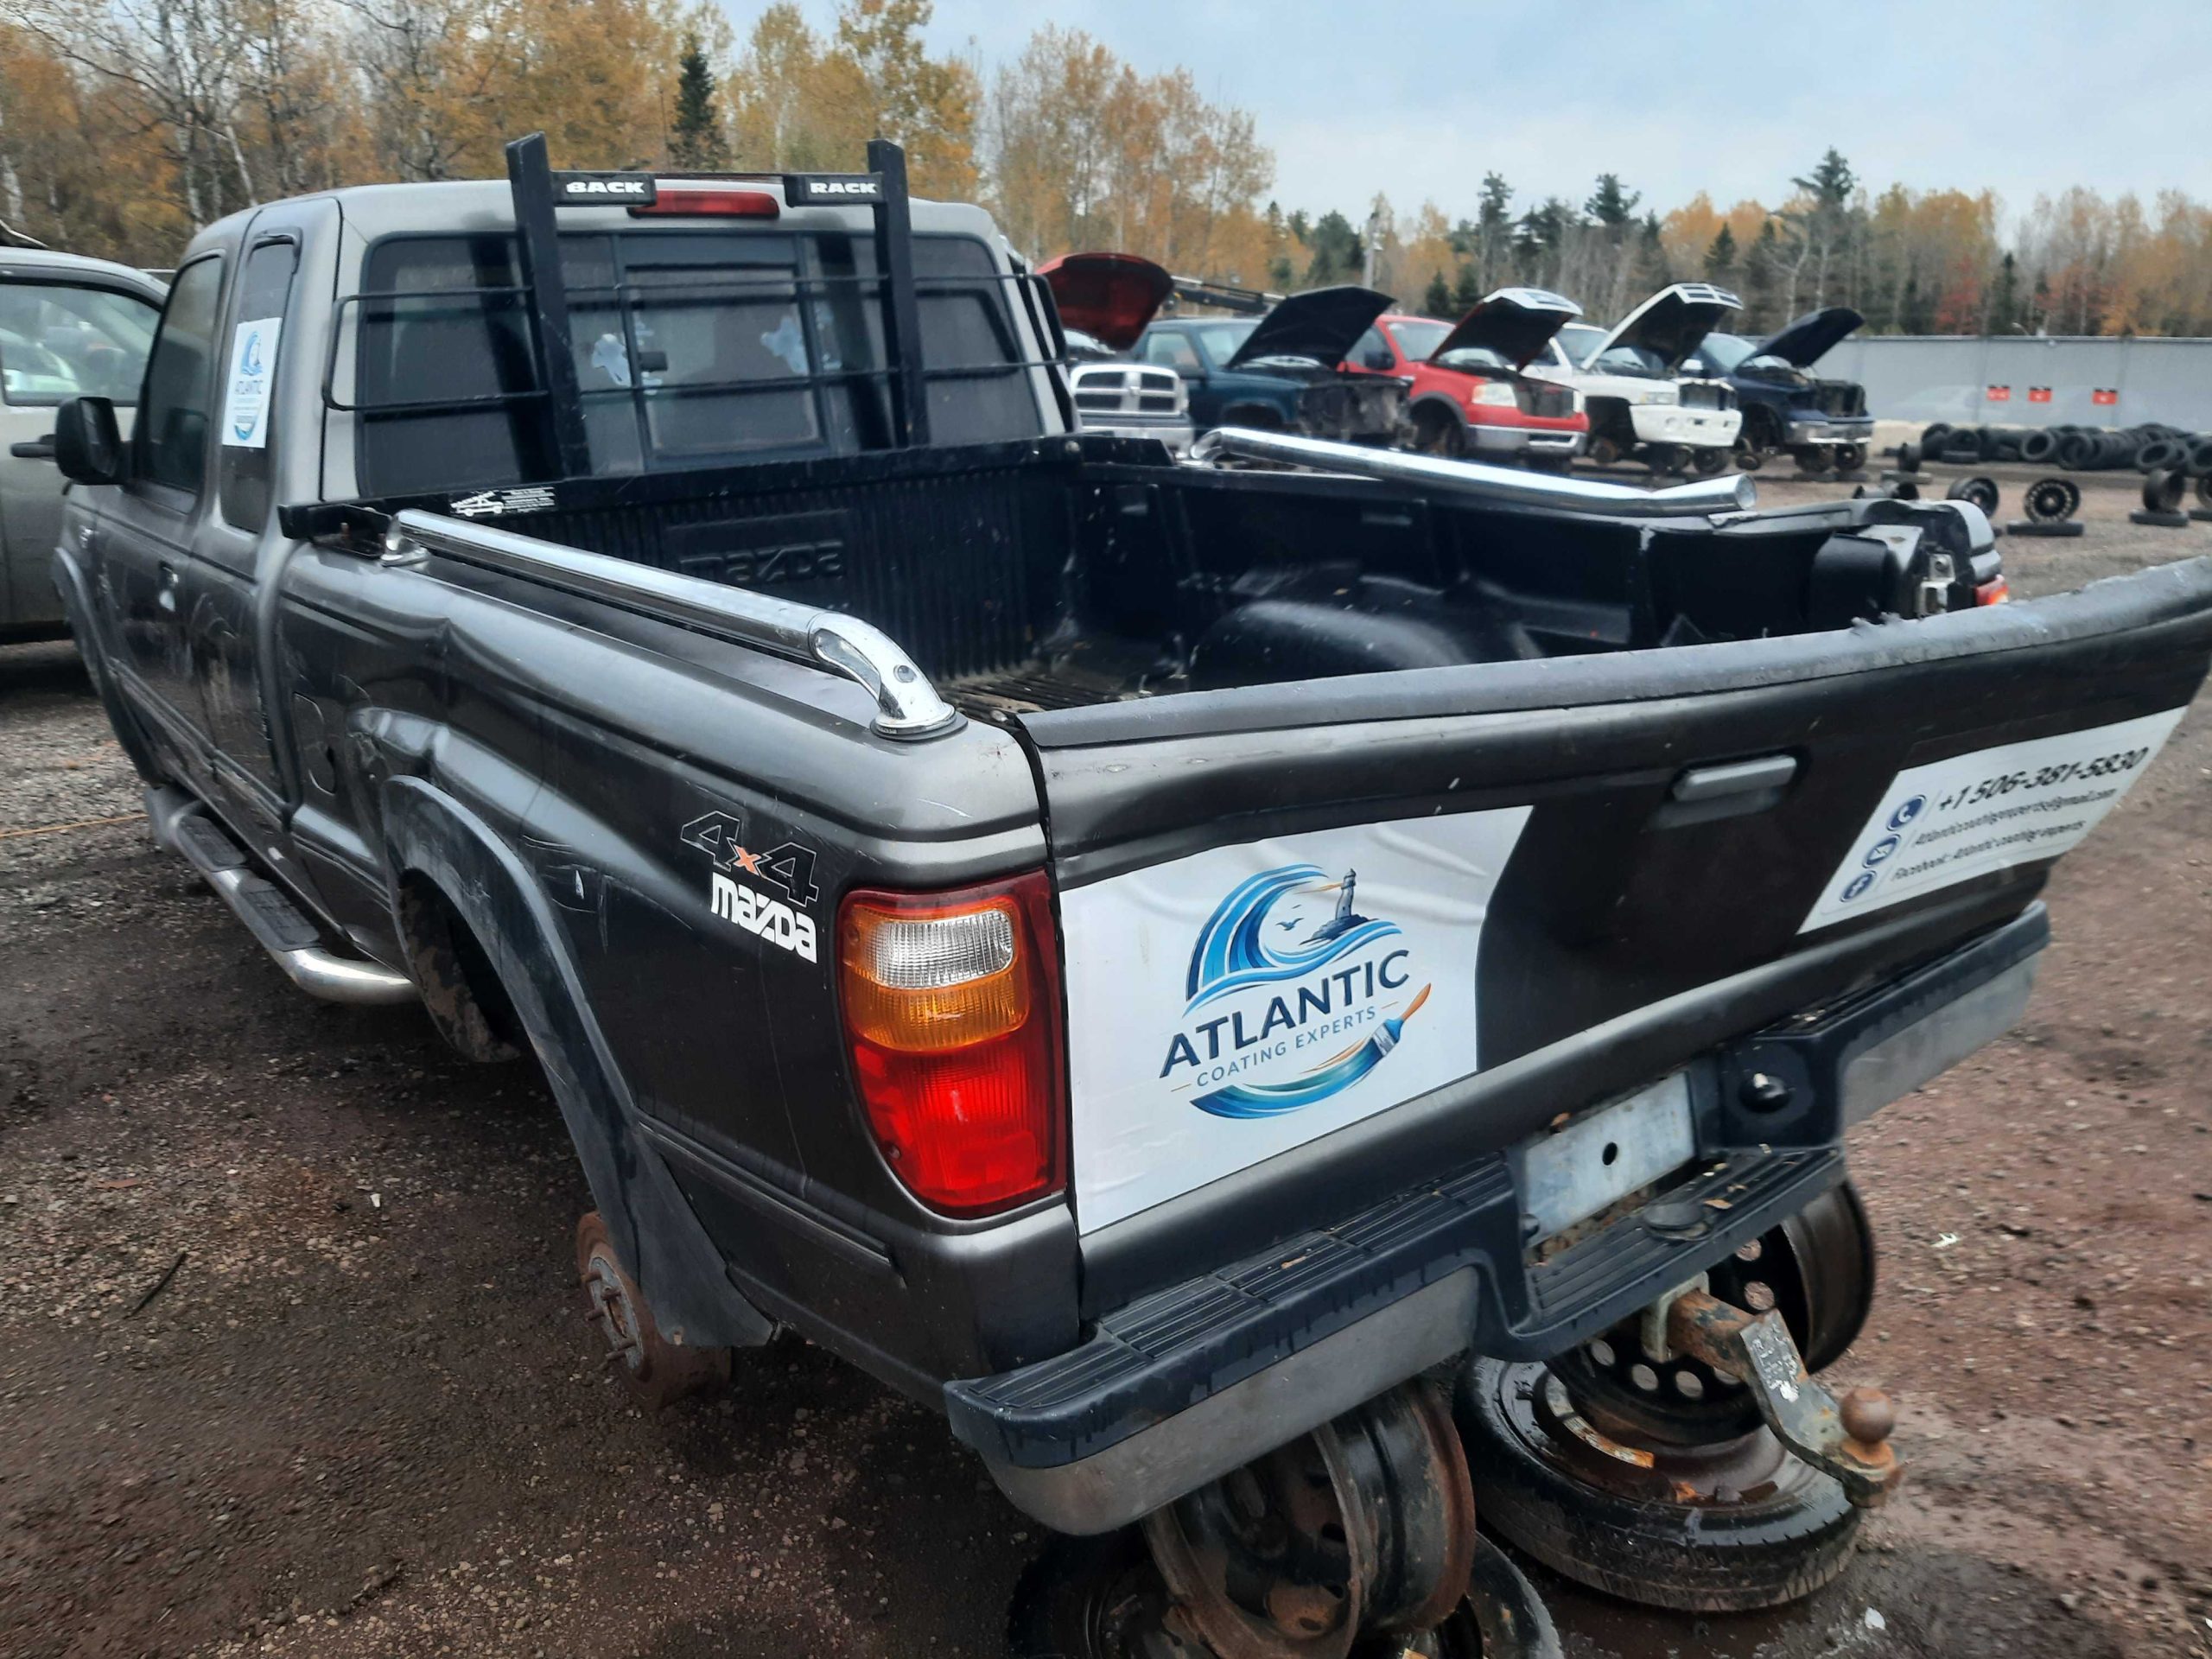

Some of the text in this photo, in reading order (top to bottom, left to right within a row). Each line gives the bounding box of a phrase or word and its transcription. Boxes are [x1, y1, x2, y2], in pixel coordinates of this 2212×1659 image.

[566, 181, 877, 194] BACK RACK
[680, 810, 820, 907] 4x4
[1159, 949, 1410, 1079] ATLANTIC
[1196, 1005, 1377, 1088] COATING EXPERTS
